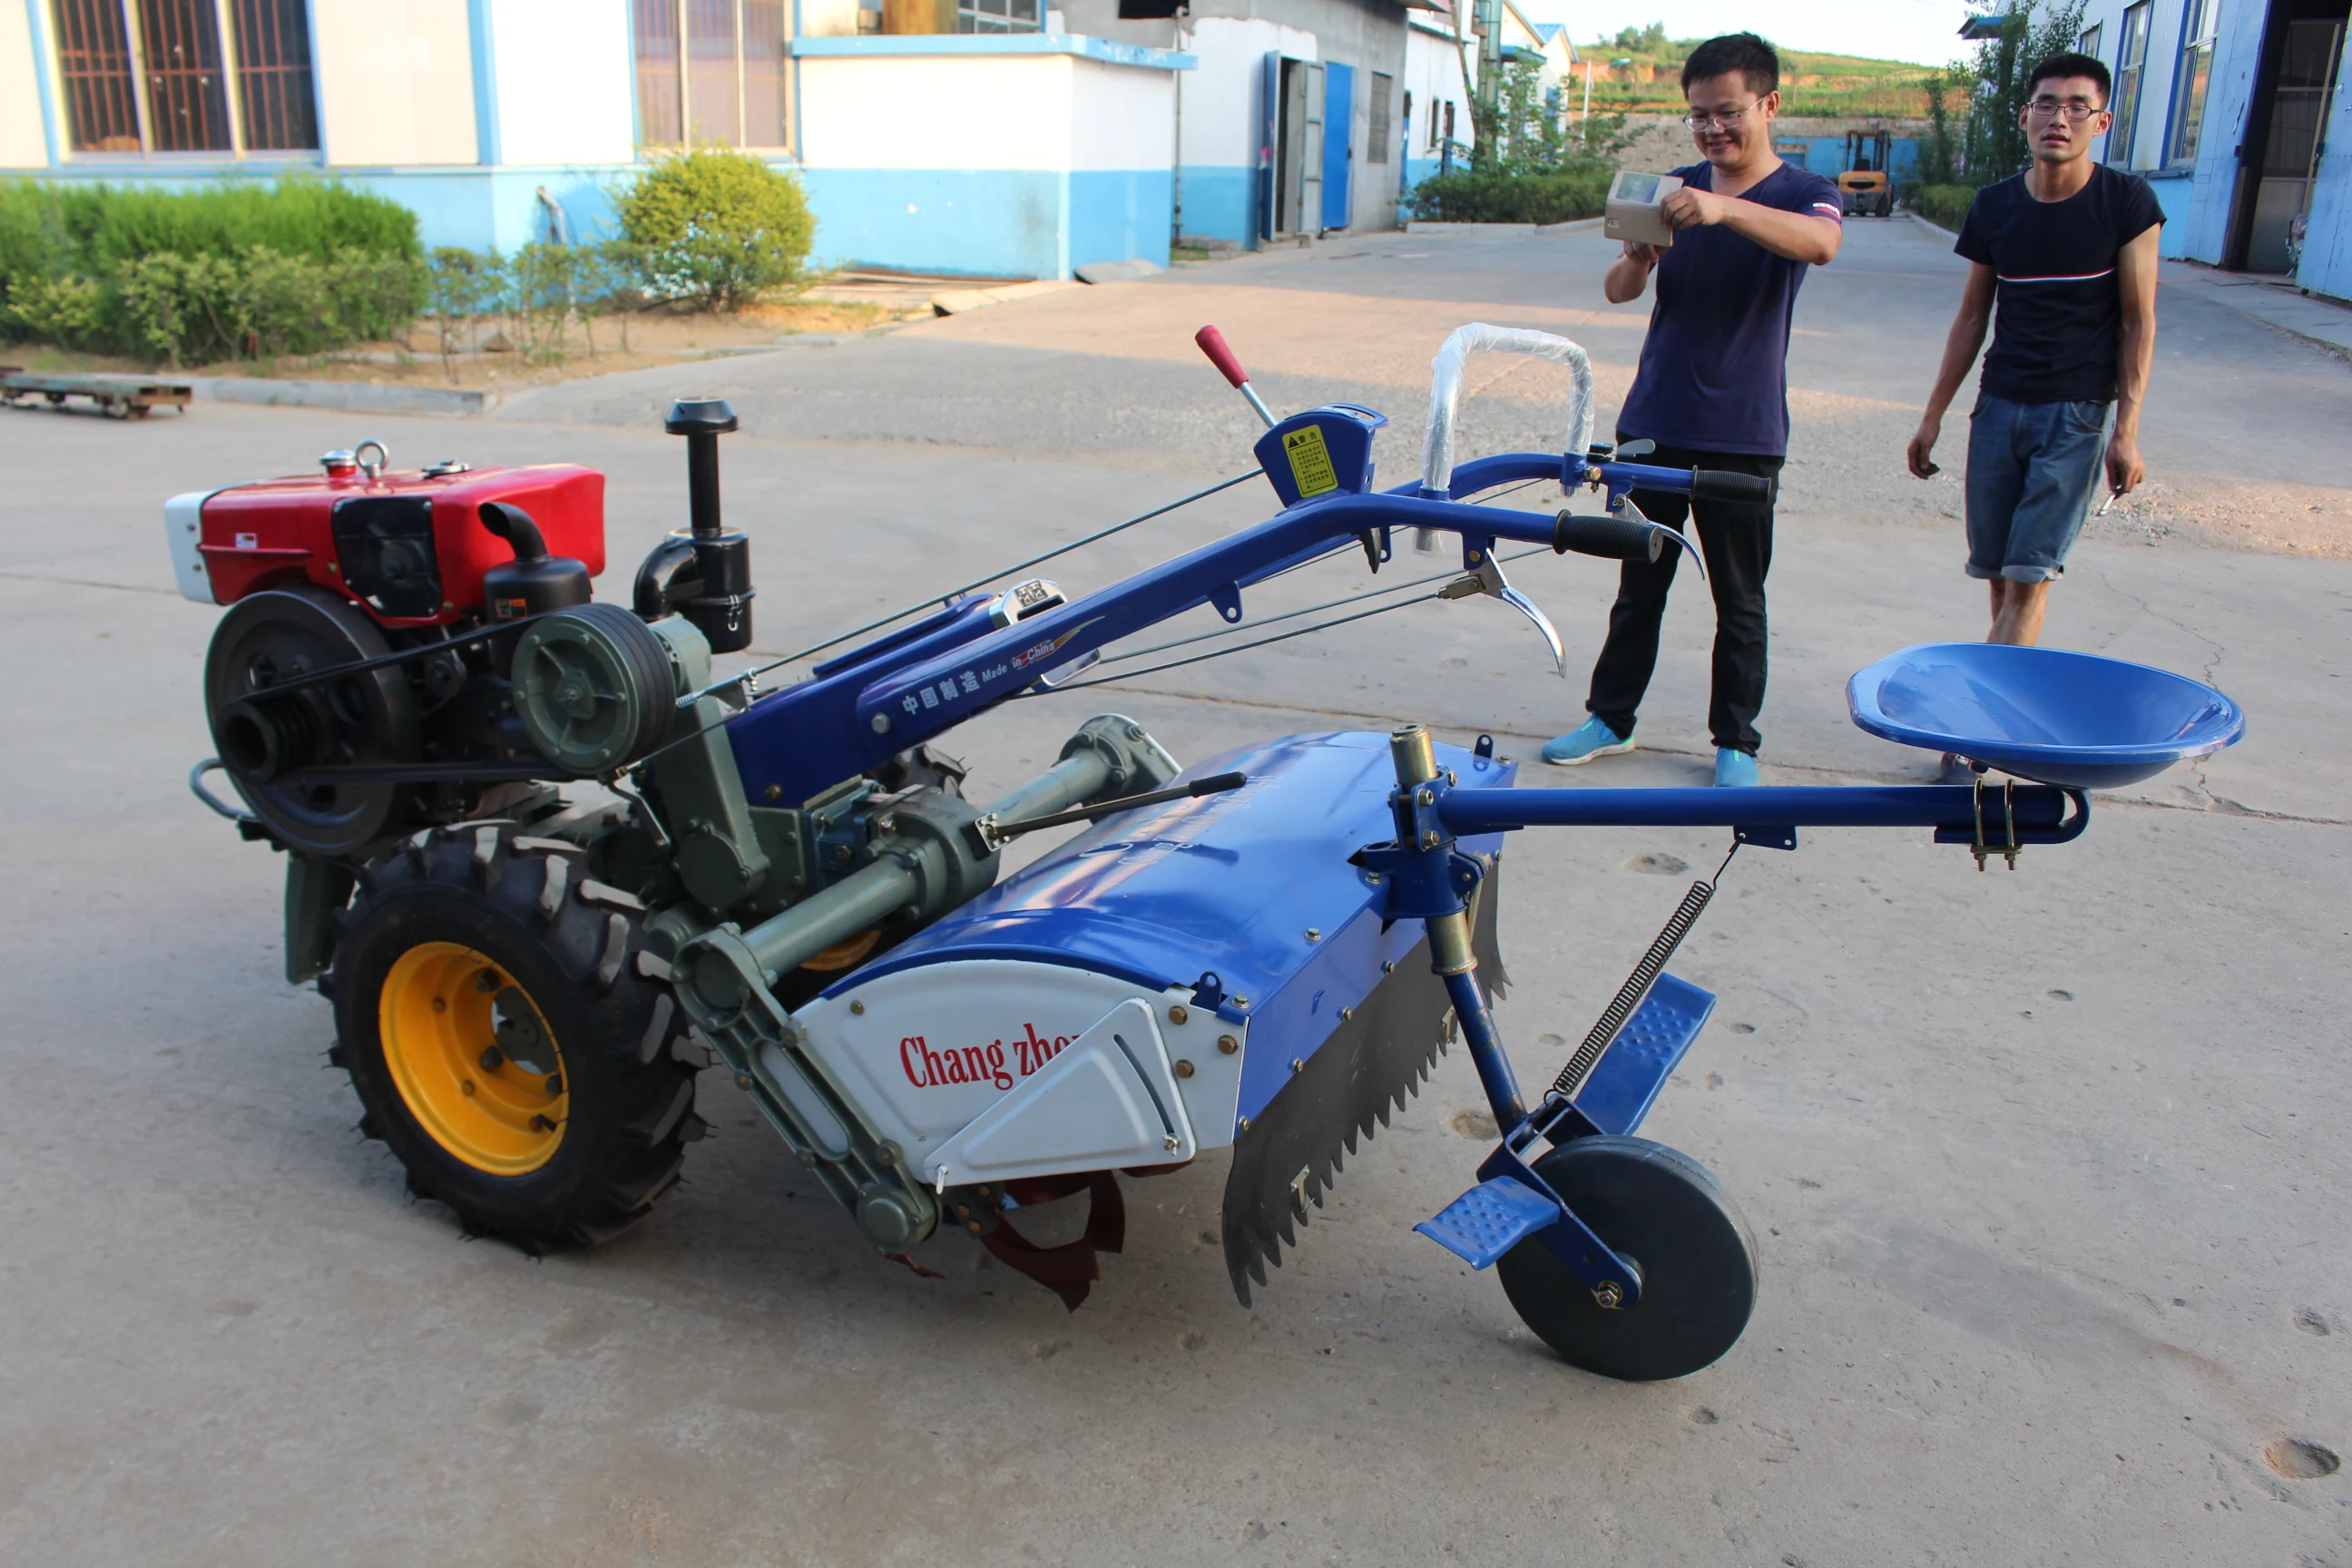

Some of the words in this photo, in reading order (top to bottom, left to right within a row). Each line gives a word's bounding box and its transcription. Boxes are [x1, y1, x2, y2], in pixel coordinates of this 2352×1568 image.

[982, 664, 1007, 682] Made
[1012, 657, 1022, 668] in
[1027, 642, 1055, 660] China
[902, 671, 980, 715] 中国制造
[900, 1036, 1013, 1090] Chang
[1013, 1023, 1081, 1076] zh
